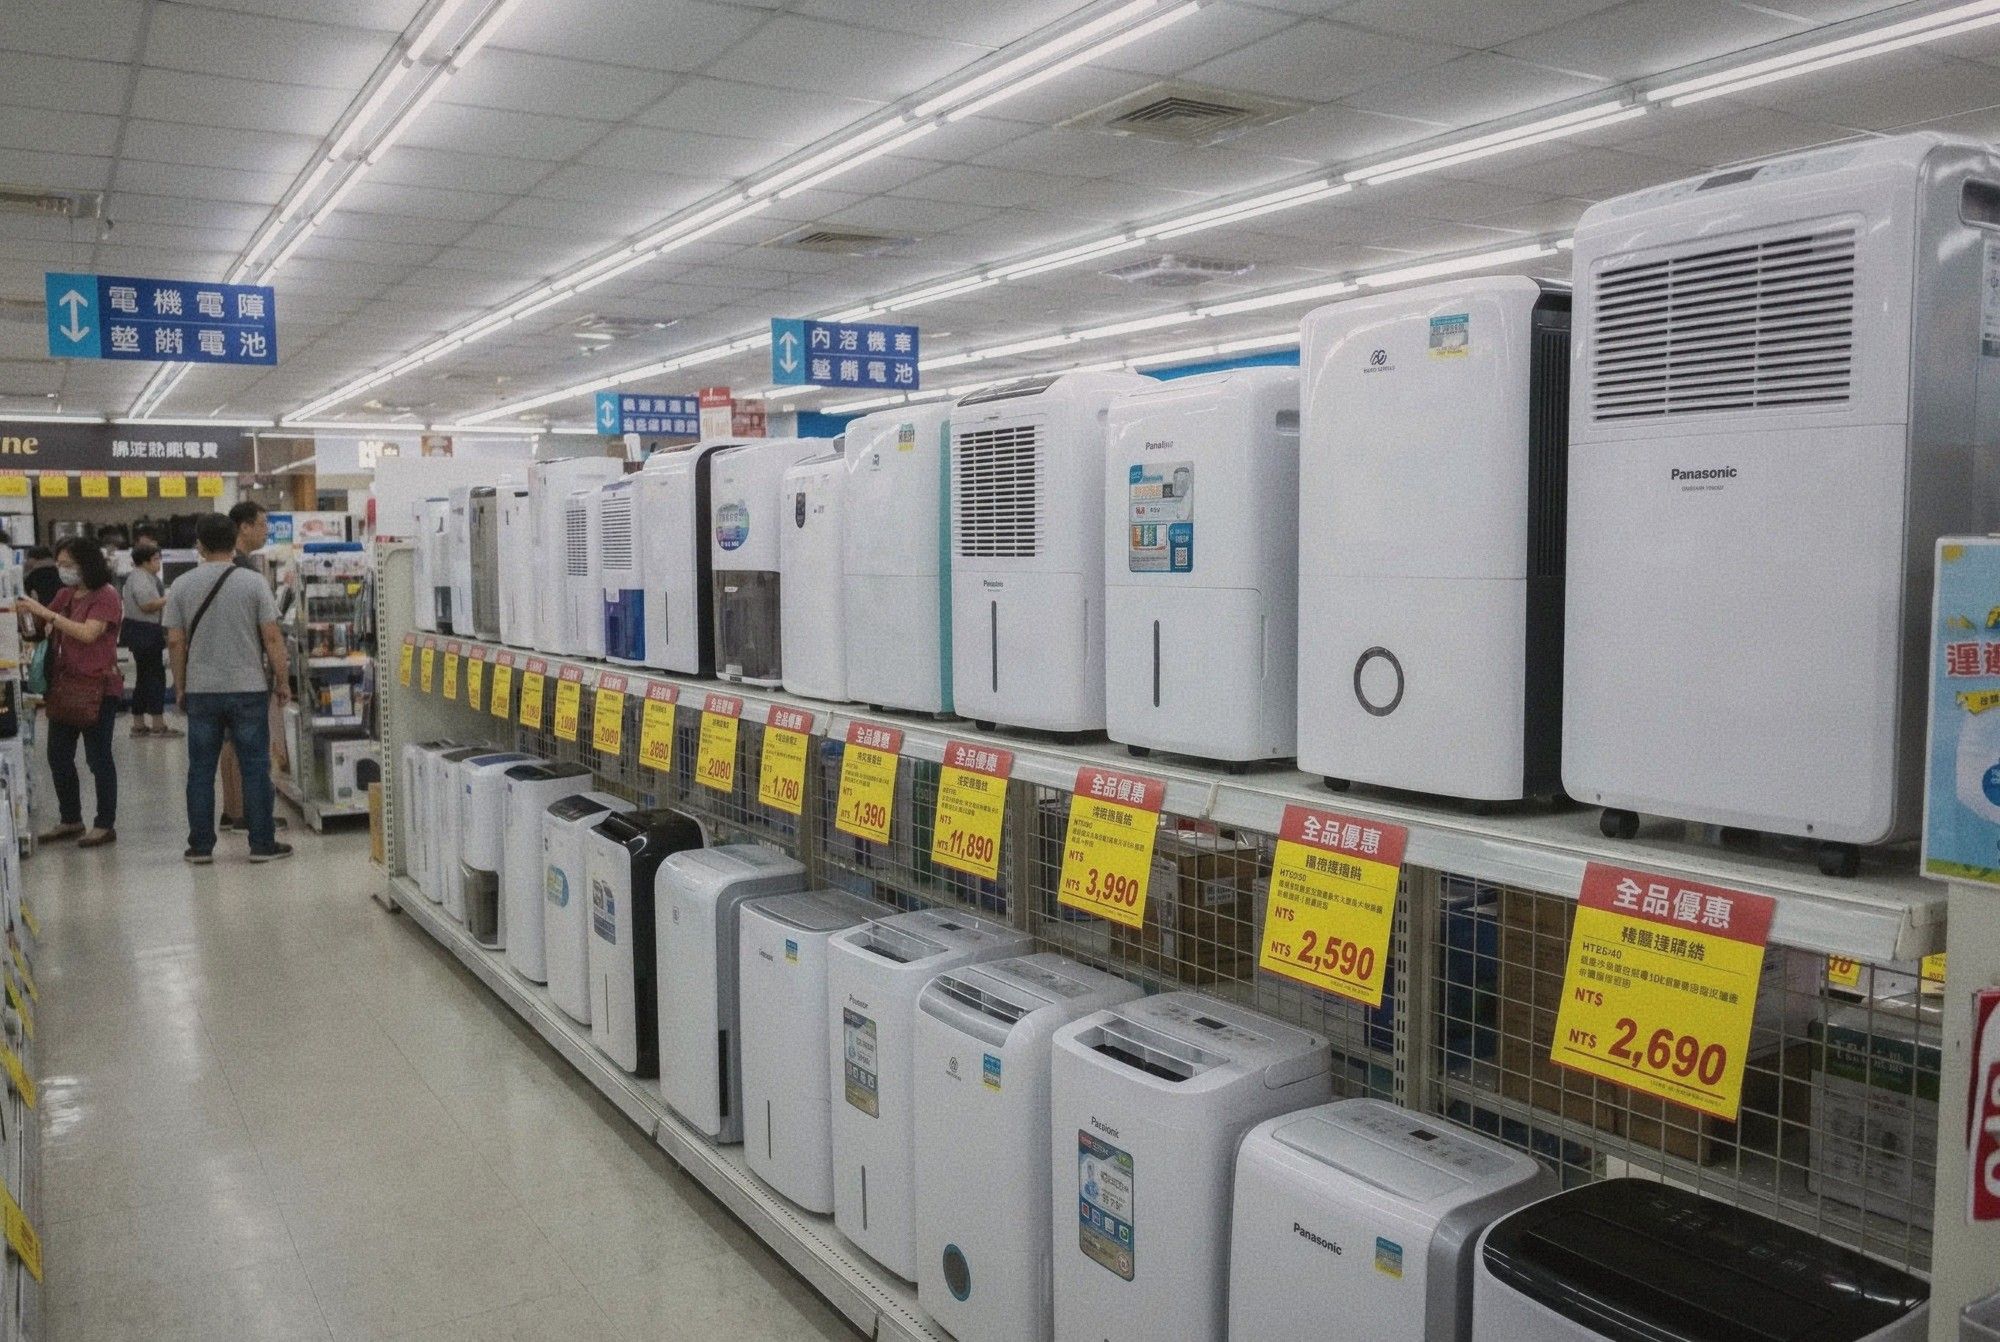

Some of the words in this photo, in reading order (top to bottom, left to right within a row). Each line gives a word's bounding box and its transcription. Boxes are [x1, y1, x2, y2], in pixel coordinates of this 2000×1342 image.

[0, 437, 39, 455] ne
[1671, 465, 1738, 481] Panasonic
[772, 775, 799, 801] 1,760
[1090, 773, 1146, 805] 全品優惠
[853, 800, 886, 829] 1,390
[949, 829, 994, 863] 11,890
[1301, 815, 1382, 855] 全品優惠
[1086, 868, 1139, 908] 3,990
[1612, 877, 1734, 929] 全品優惠
[1296, 929, 1375, 981] 2,590
[1607, 1017, 1728, 1087] 2,690
[1292, 1222, 1343, 1256] Panasonic
